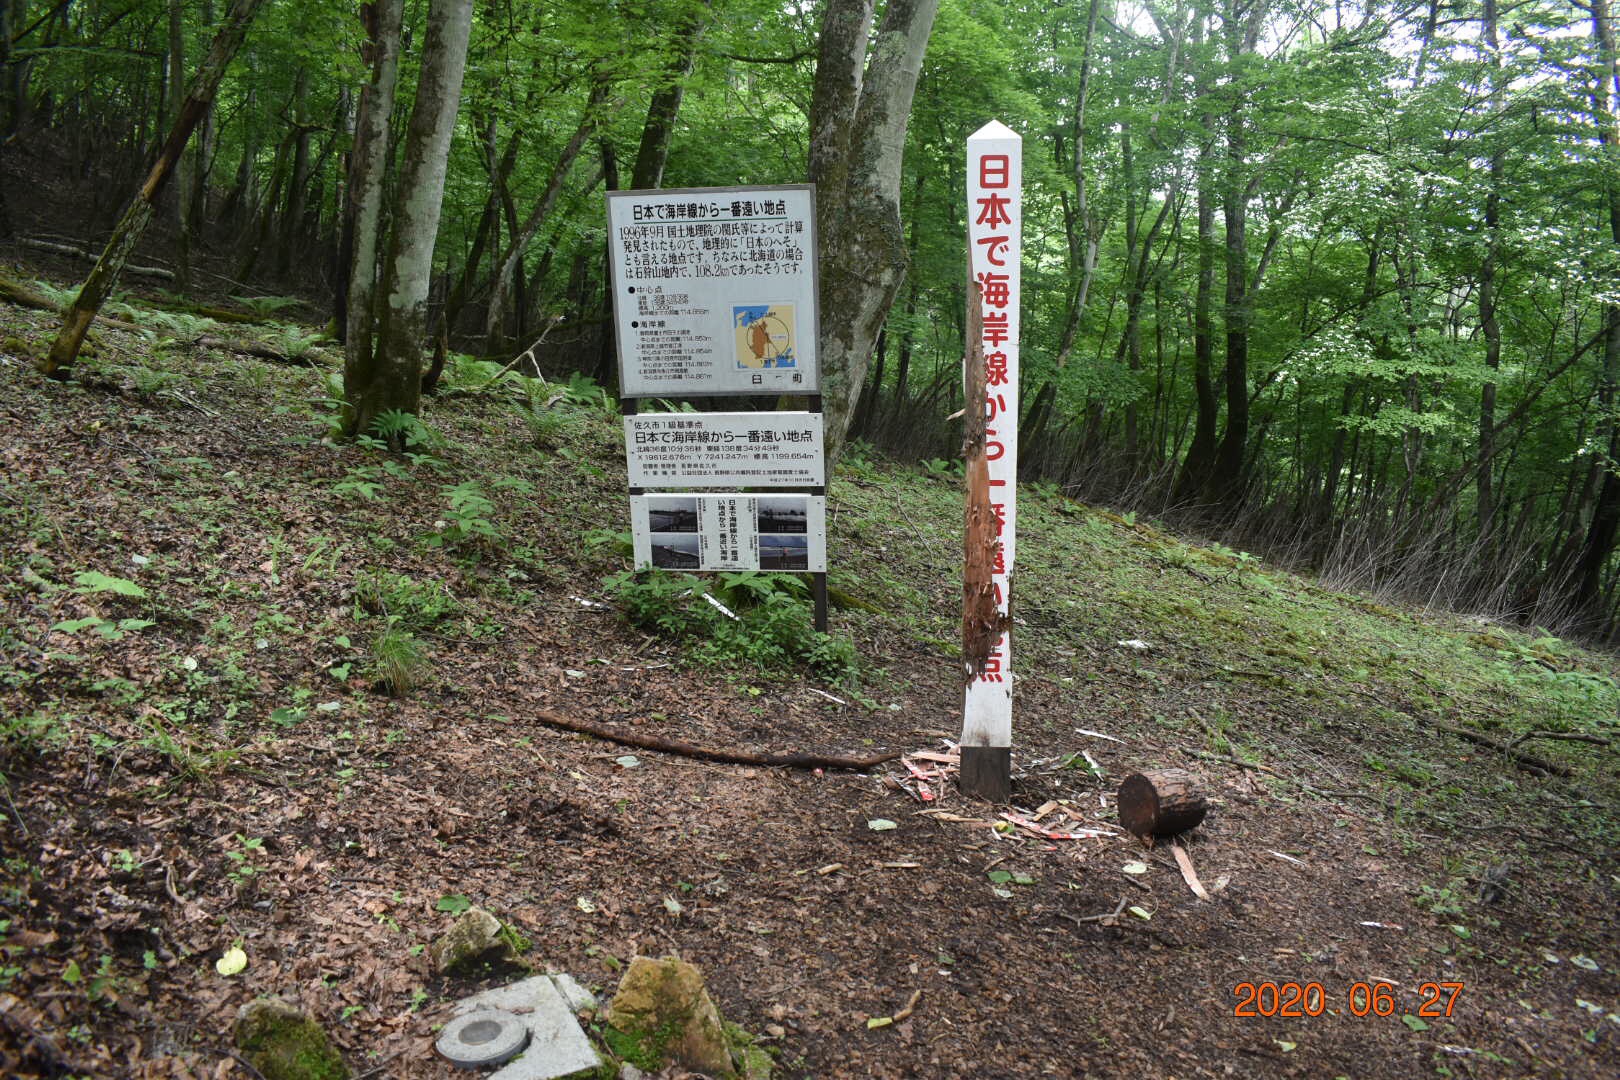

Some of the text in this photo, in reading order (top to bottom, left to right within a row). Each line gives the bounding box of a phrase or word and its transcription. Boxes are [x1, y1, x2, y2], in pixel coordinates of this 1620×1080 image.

[633, 200, 786, 220] 日本で海岸線から一番遠い地点
[635, 430, 814, 444] 日本で海岸線から一番遠い地点
